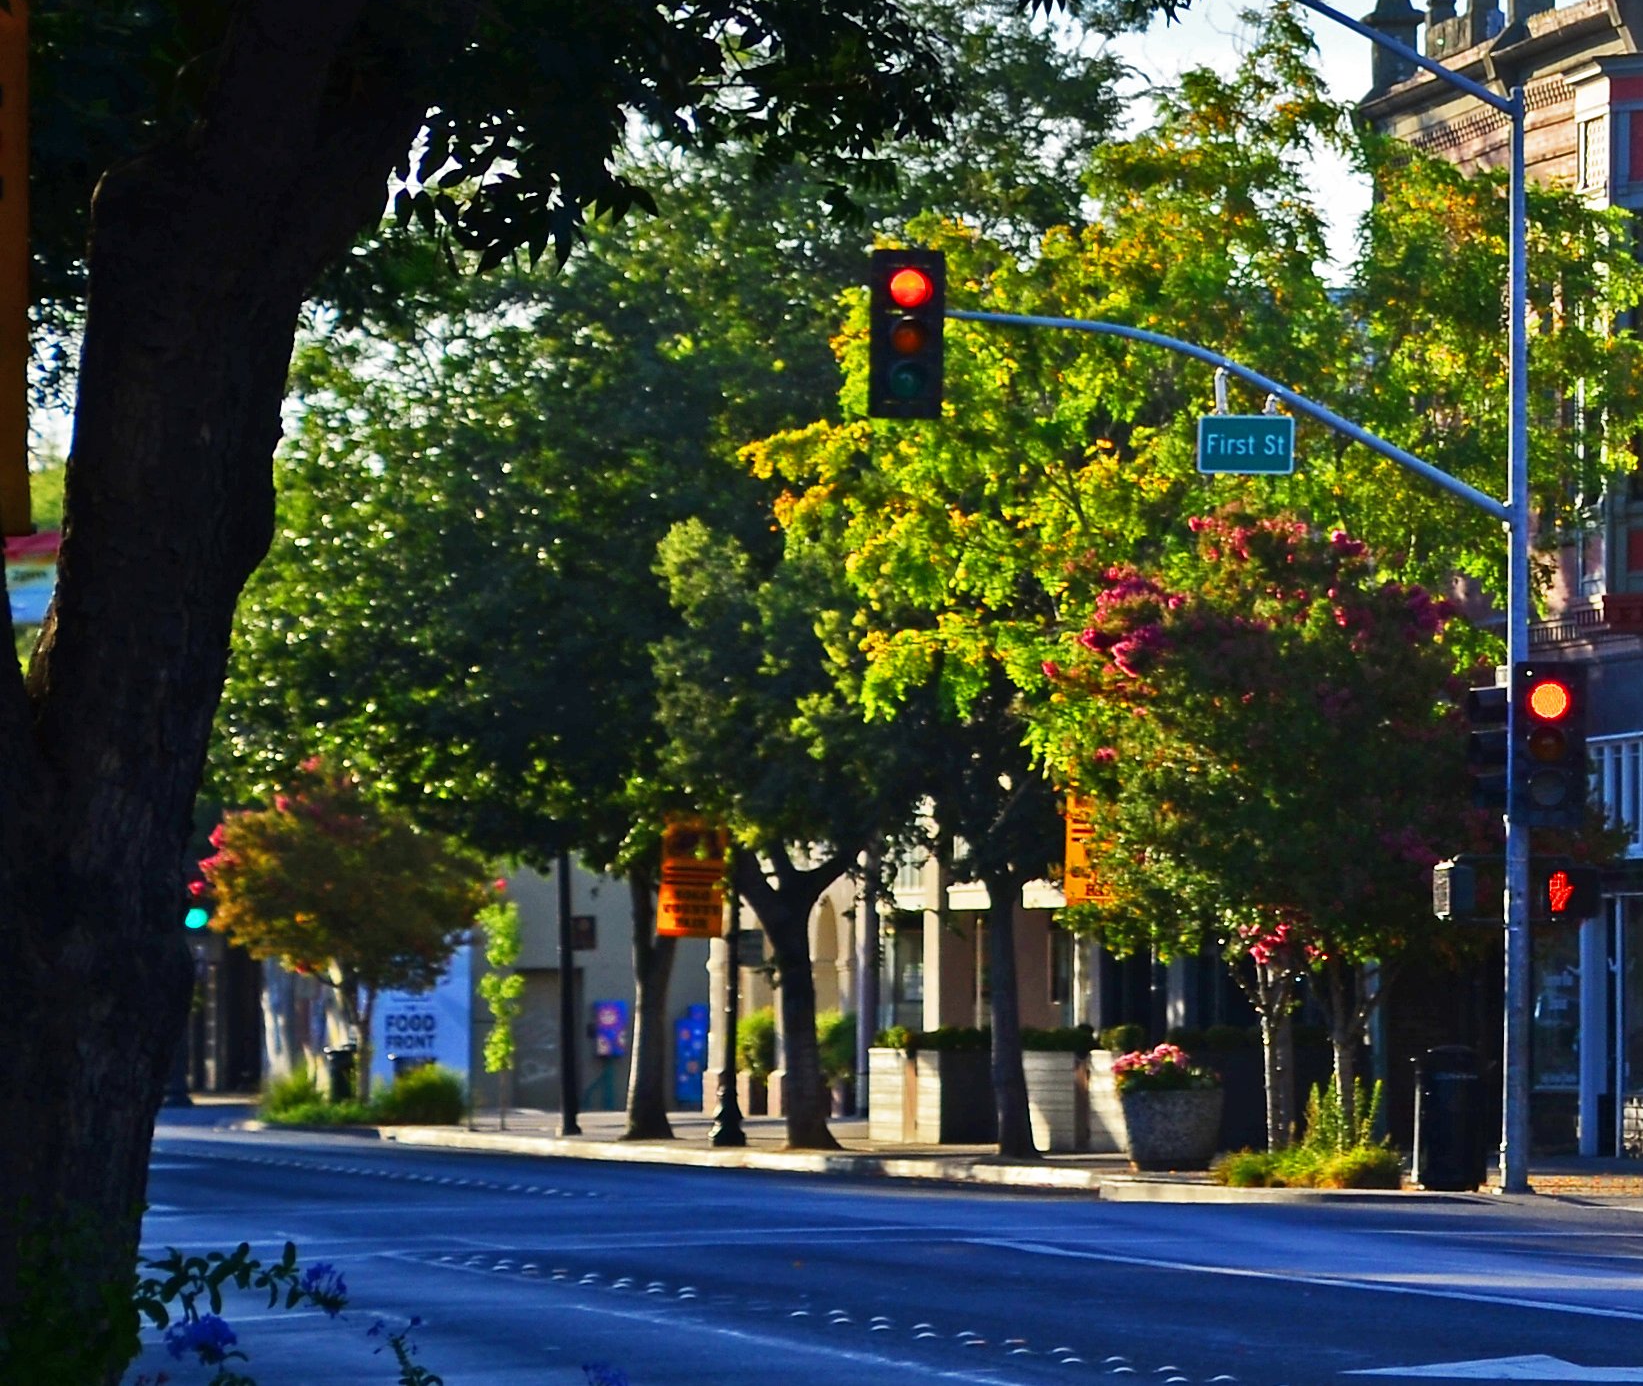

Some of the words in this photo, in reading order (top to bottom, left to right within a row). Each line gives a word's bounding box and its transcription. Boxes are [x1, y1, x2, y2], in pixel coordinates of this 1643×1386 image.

[1207, 434, 1255, 455] First
[1263, 434, 1285, 455] St
[385, 1014, 436, 1032] FOOD
[385, 1035, 436, 1050] FRONT
